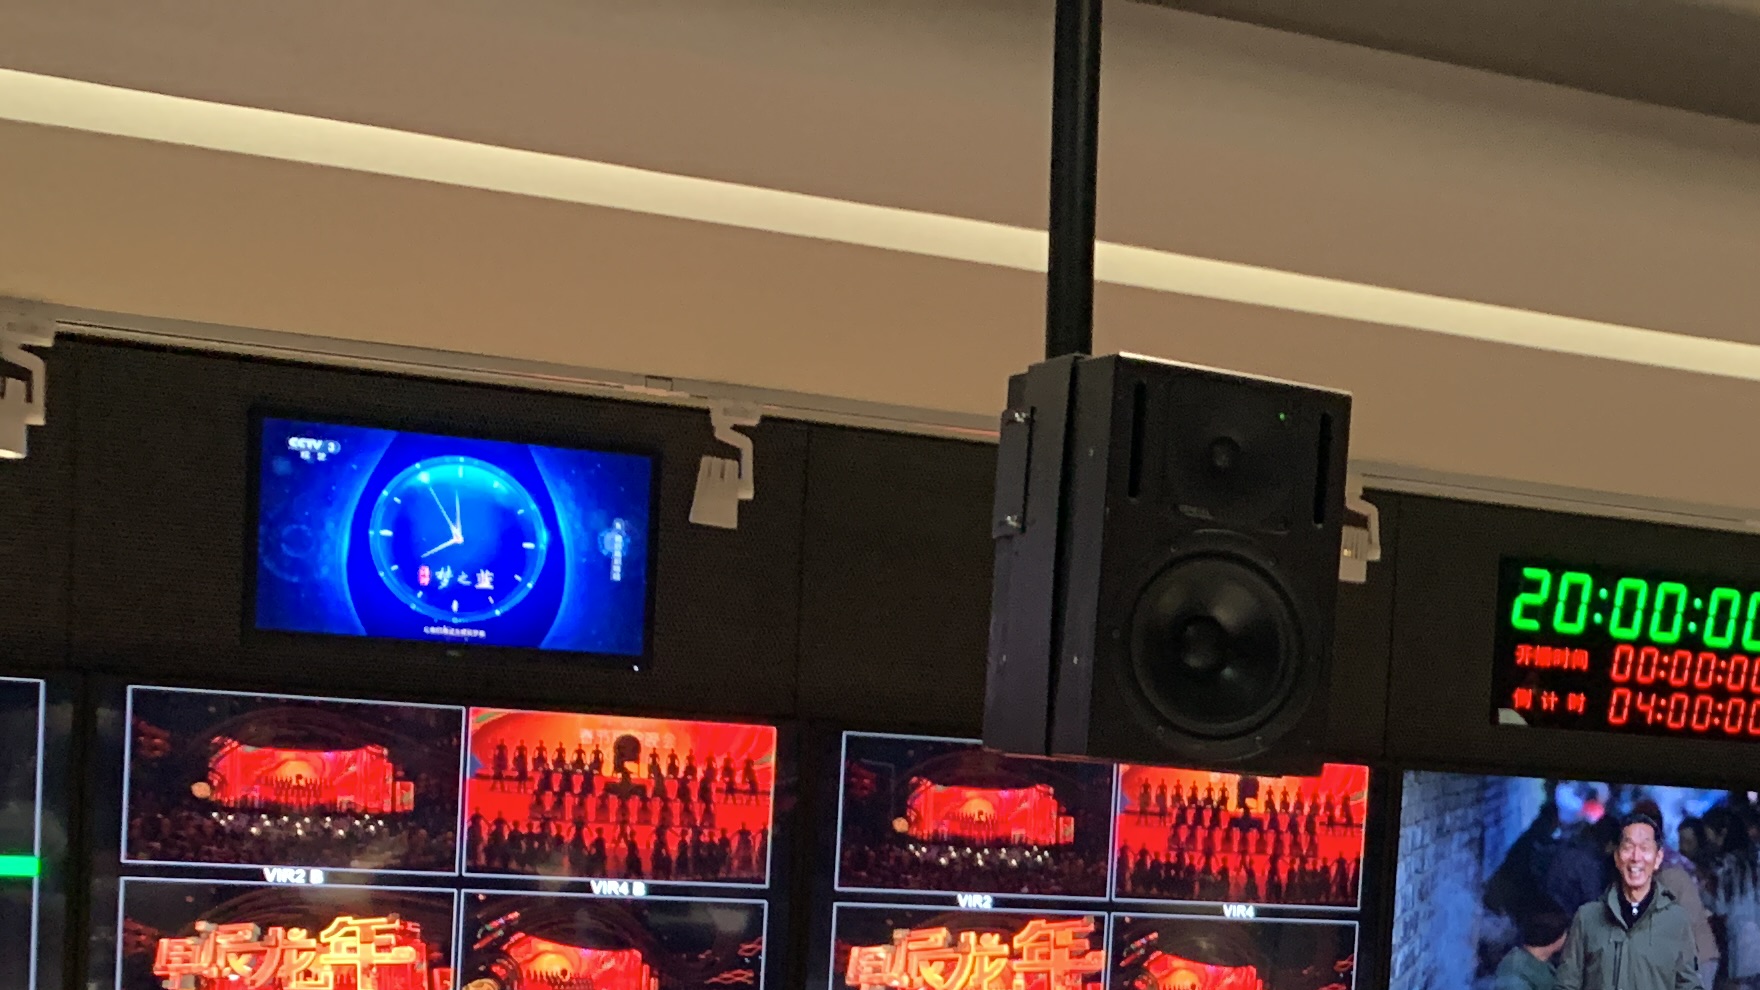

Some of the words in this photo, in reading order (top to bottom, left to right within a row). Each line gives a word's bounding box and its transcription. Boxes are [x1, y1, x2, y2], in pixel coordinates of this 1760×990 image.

[263, 867, 306, 884] VIR2
[590, 879, 628, 896] VIR4
[957, 893, 993, 909] VIR2
[1222, 903, 1256, 918] VIR4
